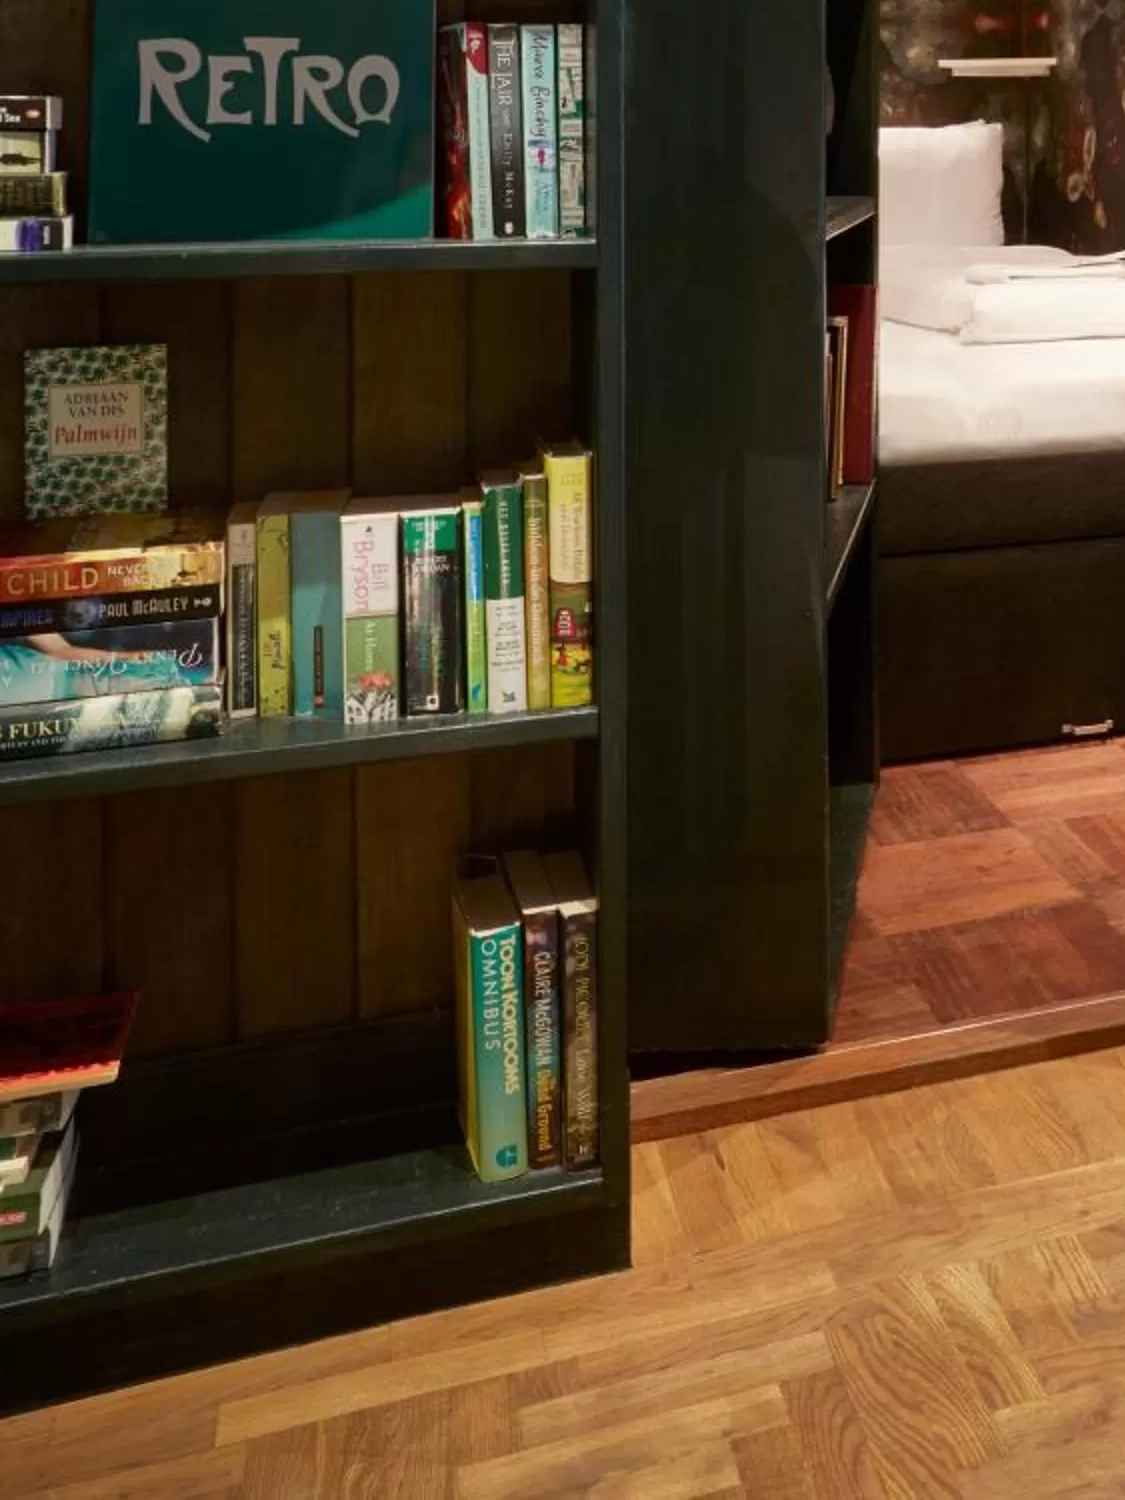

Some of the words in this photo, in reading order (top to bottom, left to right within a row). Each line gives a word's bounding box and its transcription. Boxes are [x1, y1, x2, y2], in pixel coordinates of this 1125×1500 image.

[64, 391, 128, 405] ADRIAAN
[69, 405, 97, 418] VAN
[101, 404, 126, 417] DIS
[55, 424, 137, 447] Palmwijn
[7, 566, 99, 596] CHILD
[352, 541, 376, 614] Bryson
[372, 563, 389, 590] Bill
[99, 601, 130, 618] PAUL
[132, 596, 189, 616] McAULEY
[499, 933, 517, 989] TOON
[533, 950, 552, 997] CLAIRE
[575, 934, 590, 972] JODI
[480, 938, 501, 1052] OMNIBUS
[502, 989, 521, 1095] KORTOOMS
[535, 997, 553, 1067] McGOWAN
[537, 1102, 553, 1152] Ground
